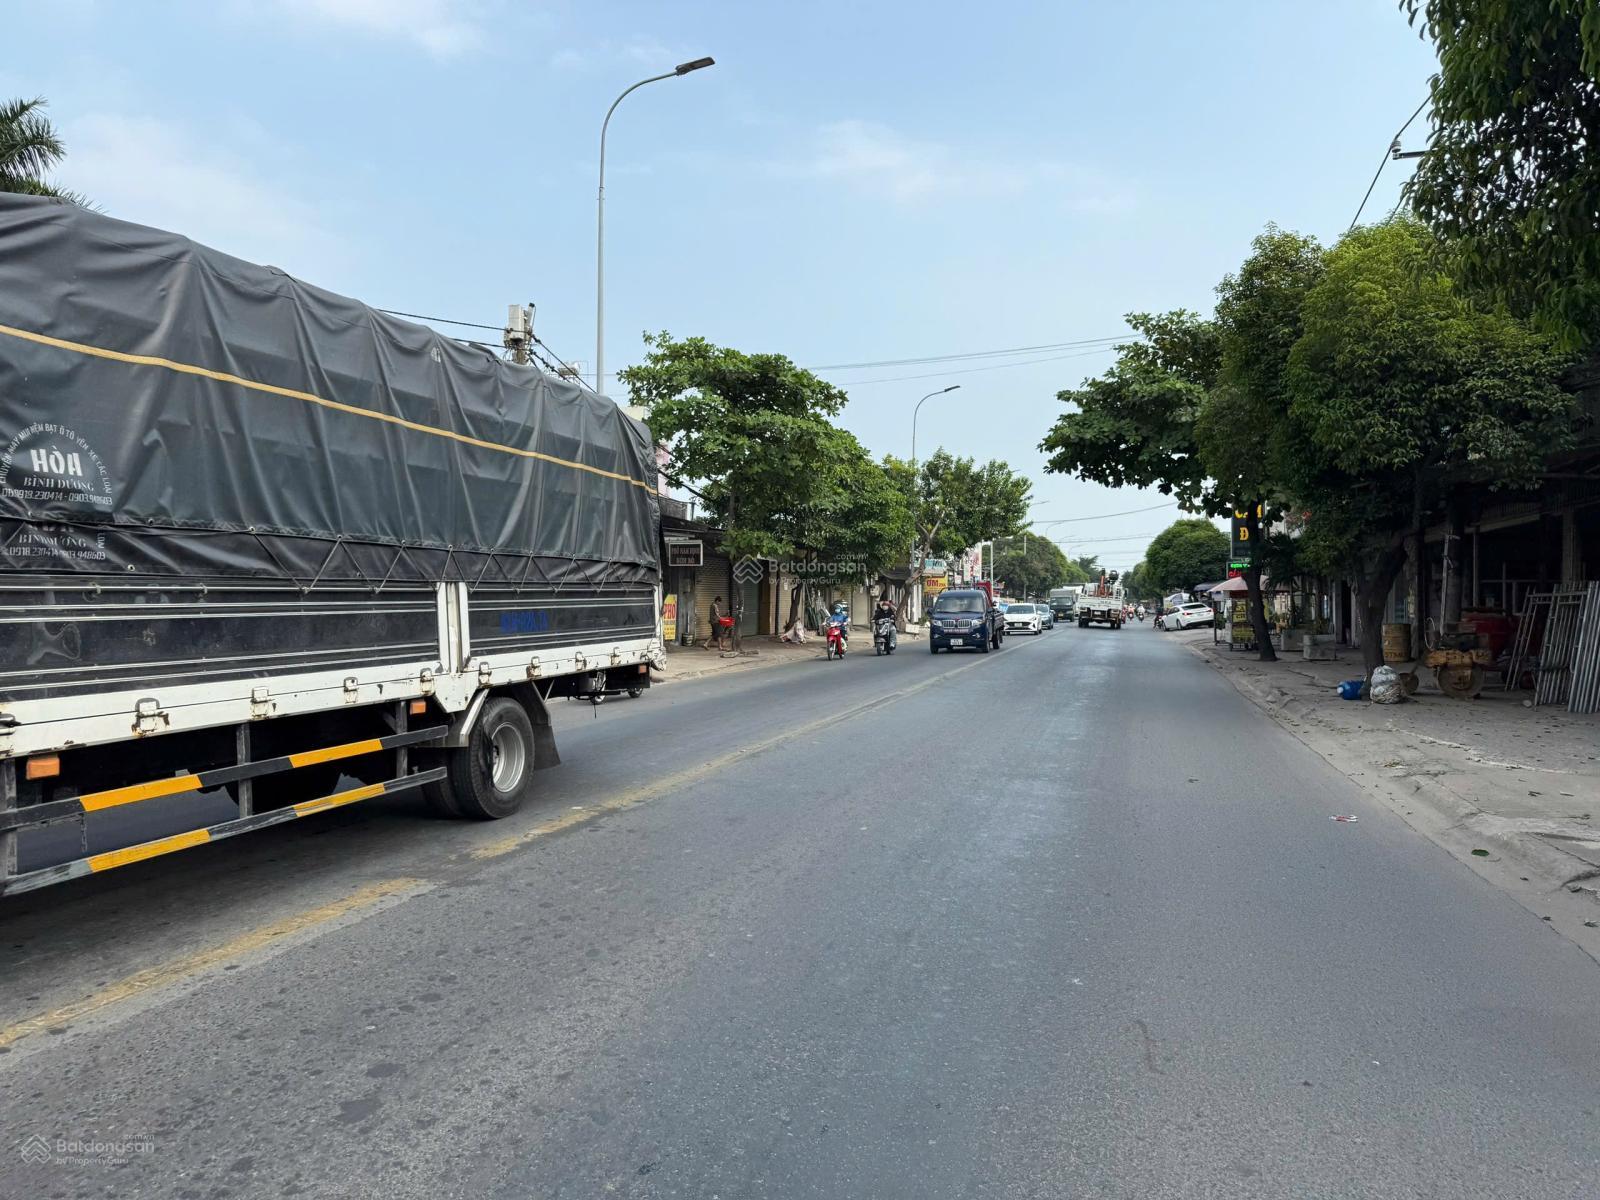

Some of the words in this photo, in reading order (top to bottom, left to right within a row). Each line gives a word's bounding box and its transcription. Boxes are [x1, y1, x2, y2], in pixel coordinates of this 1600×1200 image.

[45, 423, 58, 434] BẠT
[66, 429, 75, 440] TÔ
[30, 445, 83, 477] HÒA
[24, 475, 53, 489] BÌNH
[57, 478, 95, 492] DƯƠNG
